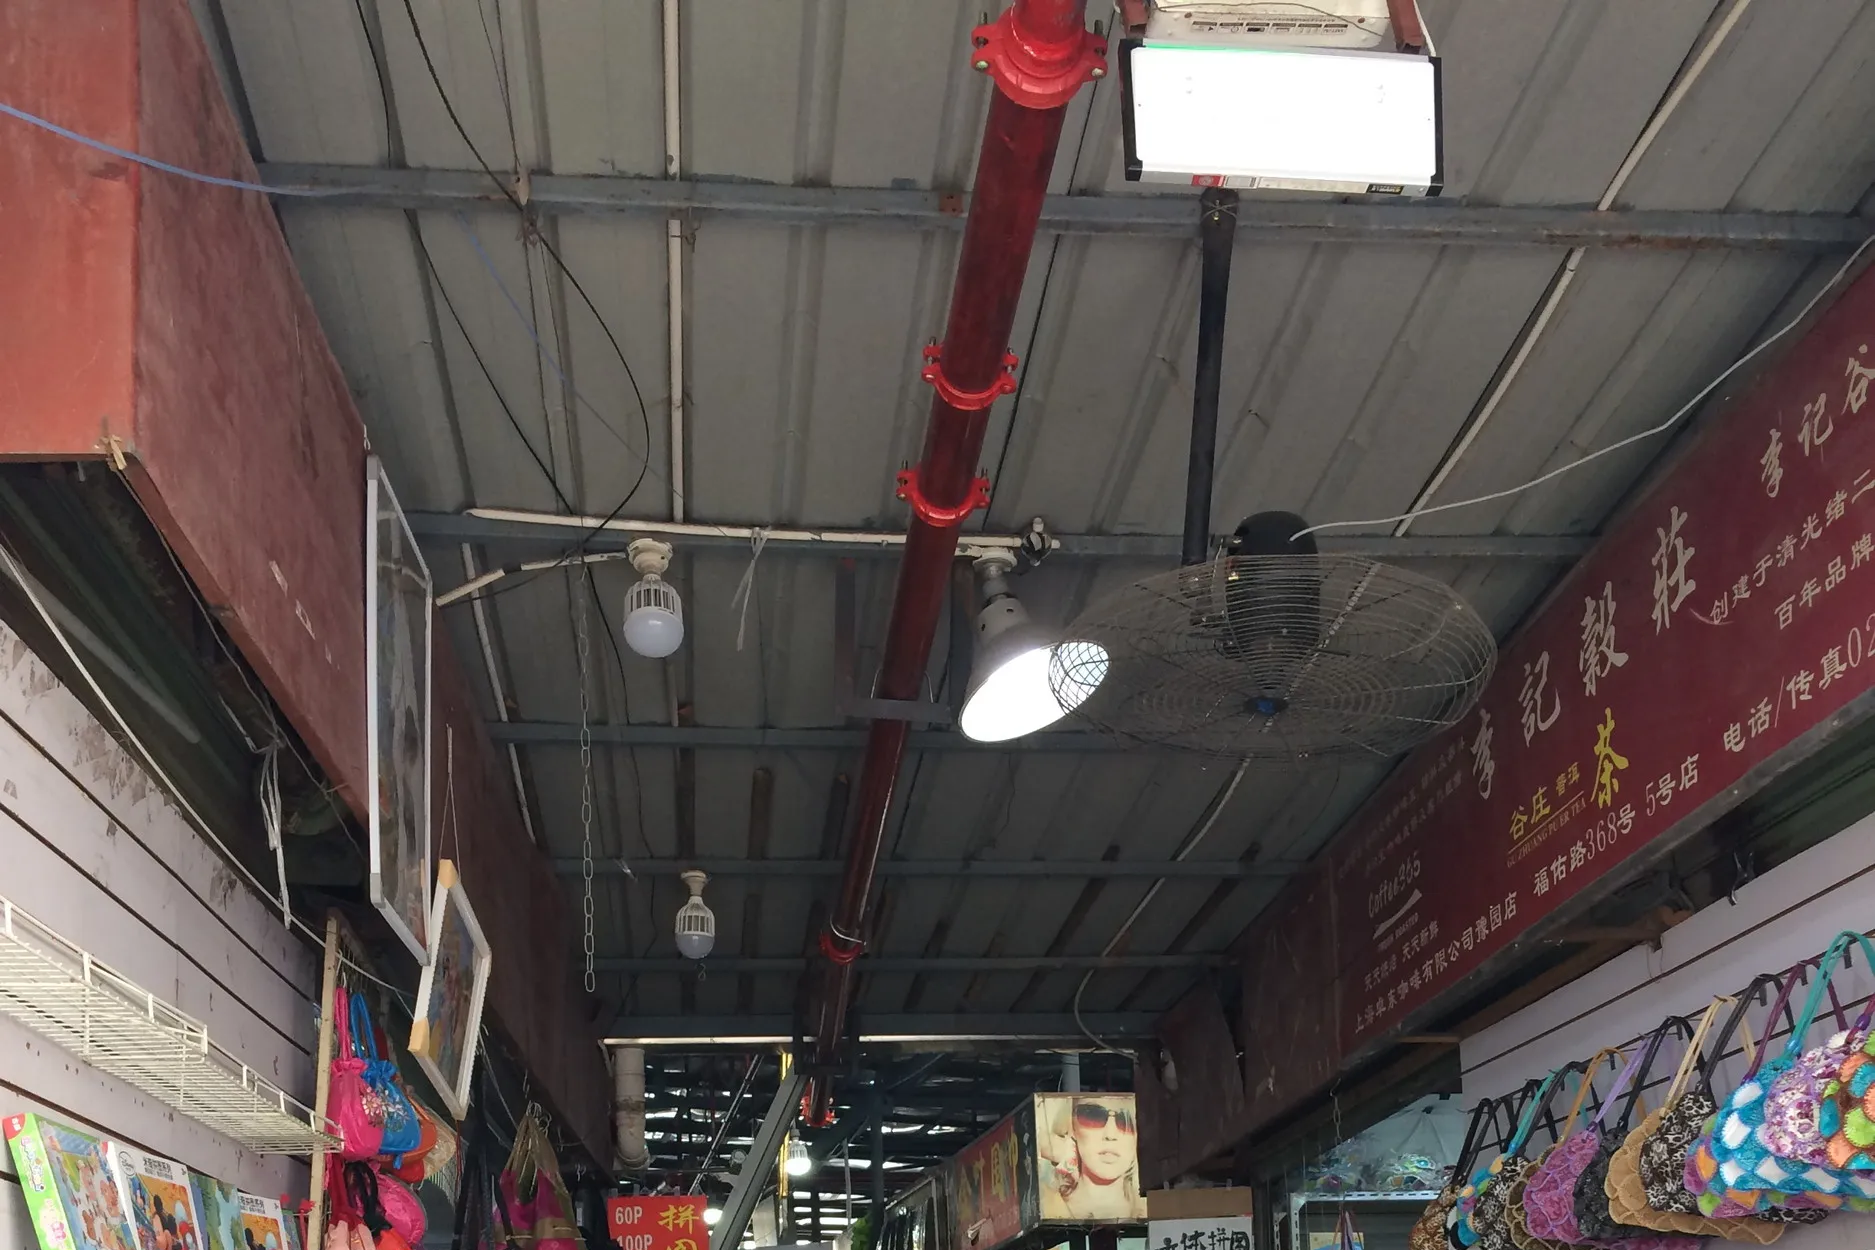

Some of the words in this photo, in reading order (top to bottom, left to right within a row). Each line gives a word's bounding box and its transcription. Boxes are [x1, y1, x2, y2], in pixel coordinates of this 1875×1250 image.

[1774, 532, 1875, 630] 百年品牌
[1509, 786, 1551, 841] 谷庄
[1590, 707, 1630, 810] 茶
[1533, 803, 1636, 897] 福佑路368号
[1645, 753, 1700, 817] 5号店
[615, 1206, 643, 1225] 60P
